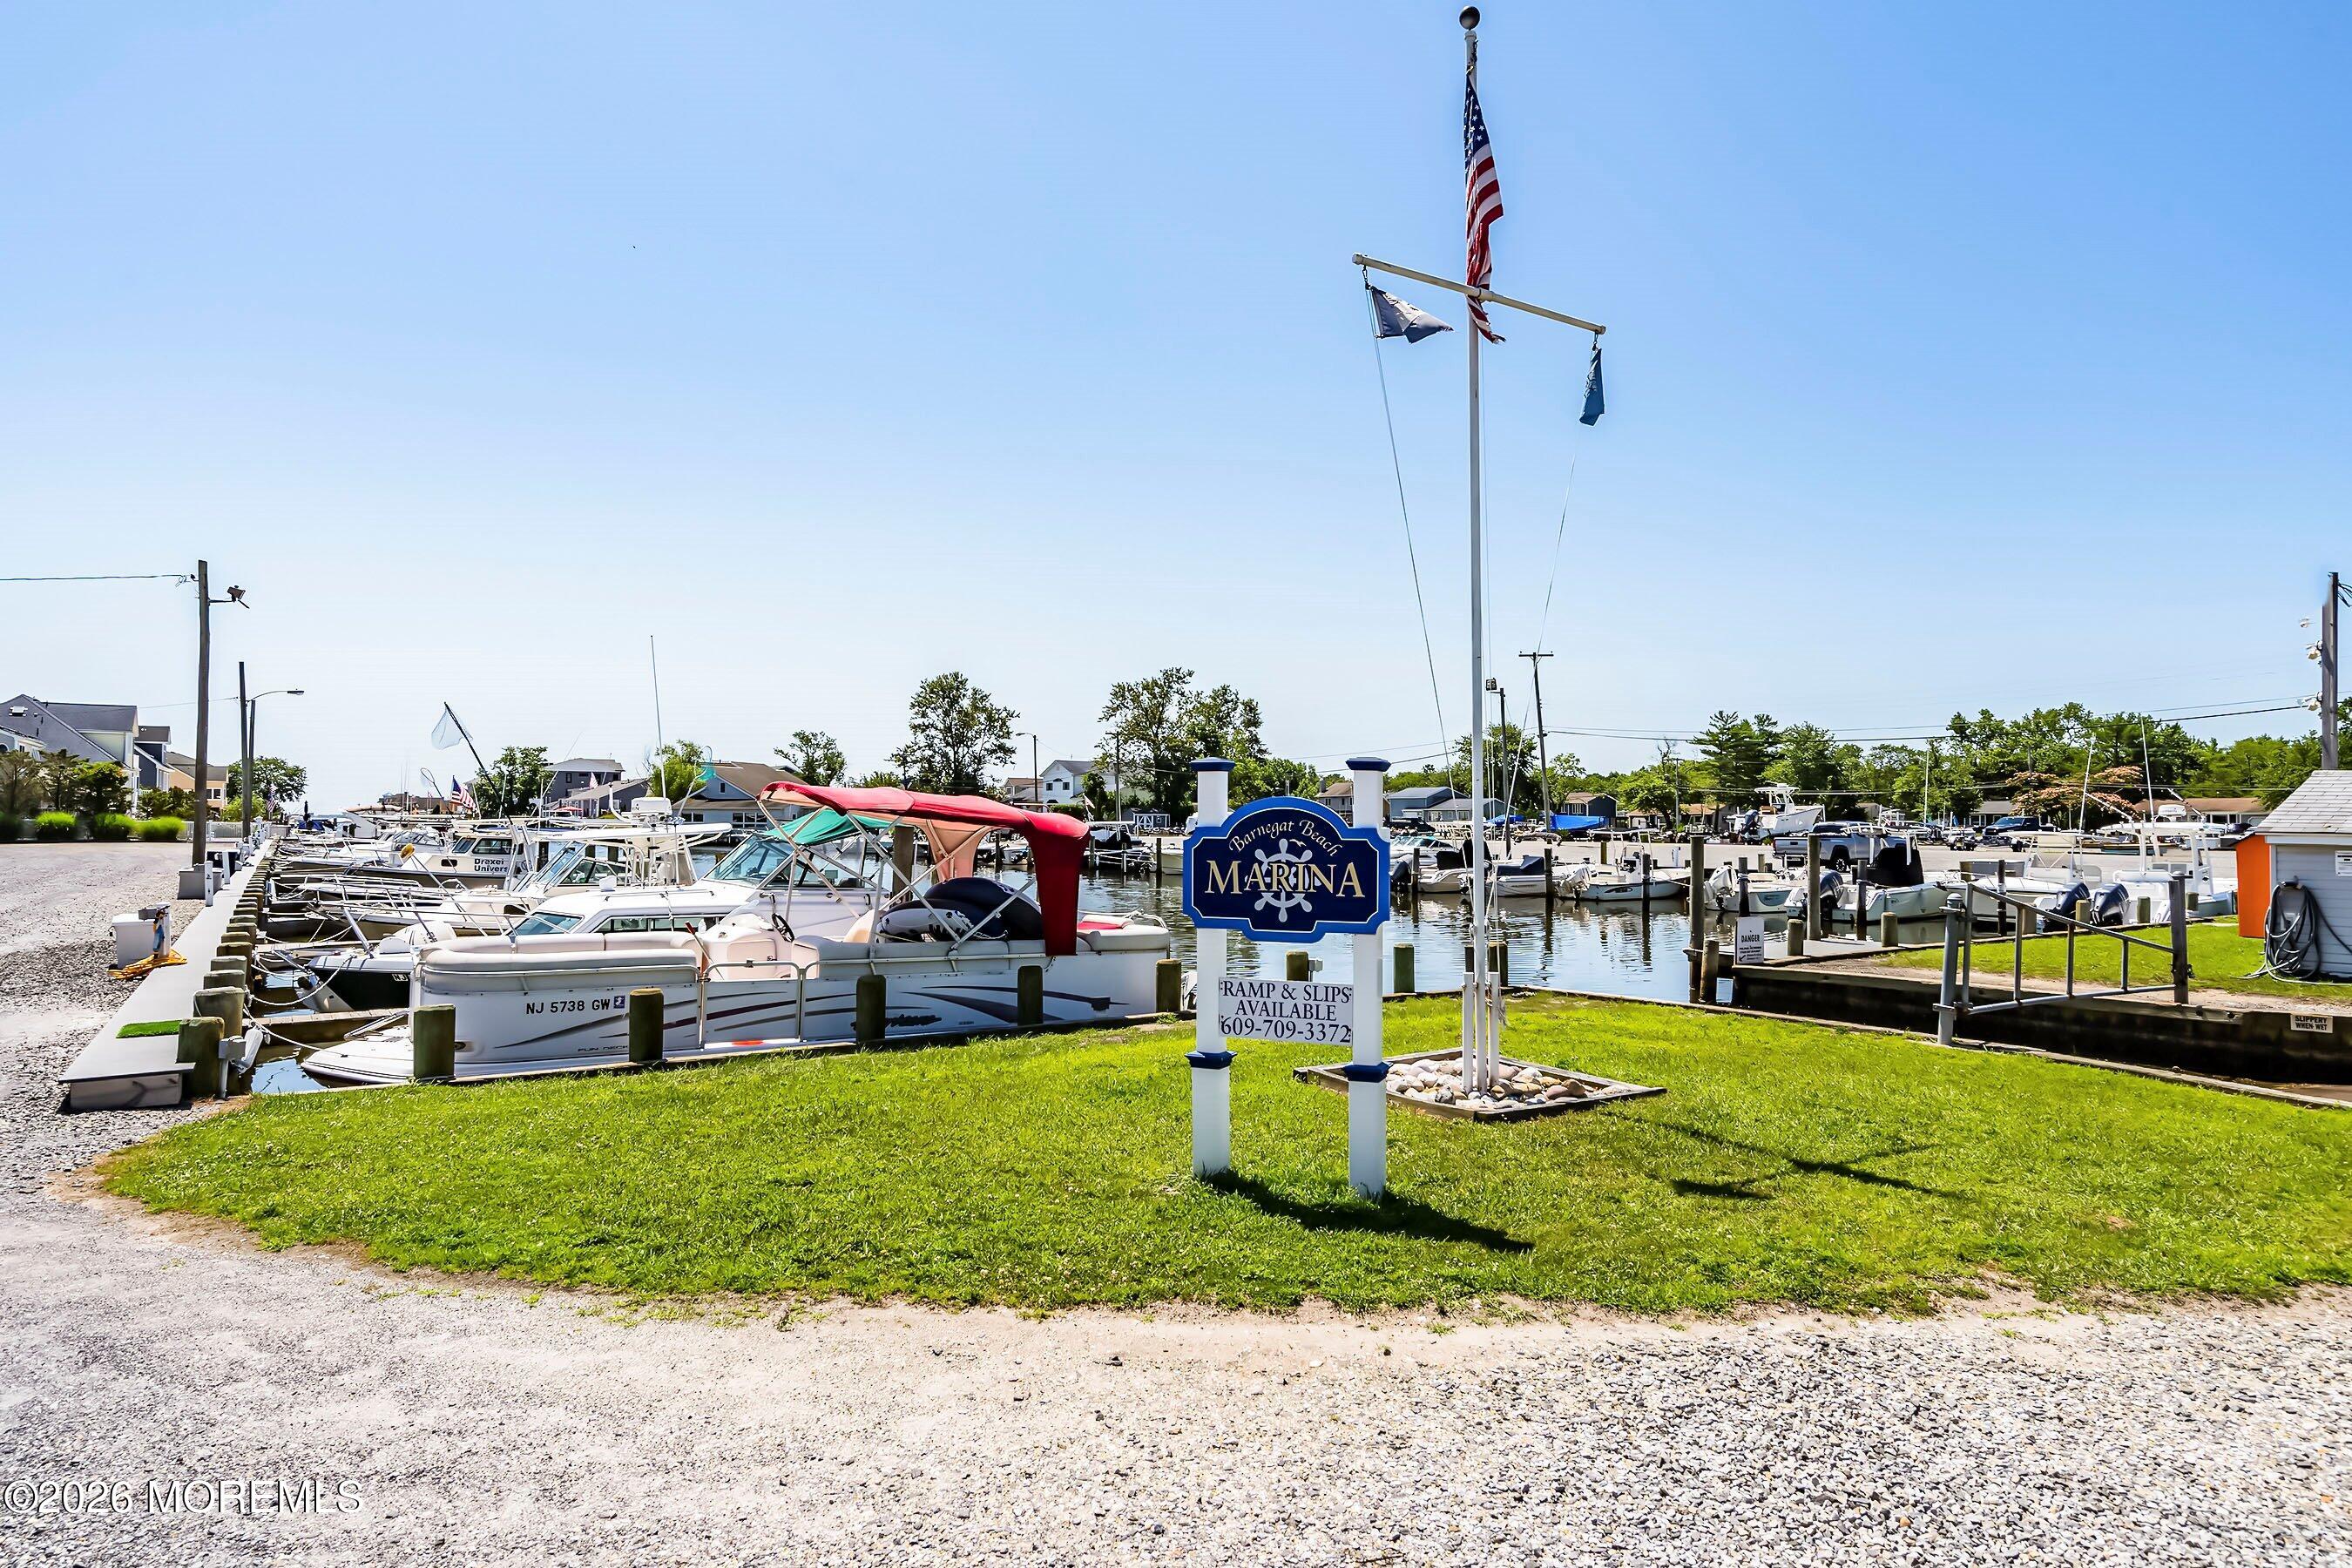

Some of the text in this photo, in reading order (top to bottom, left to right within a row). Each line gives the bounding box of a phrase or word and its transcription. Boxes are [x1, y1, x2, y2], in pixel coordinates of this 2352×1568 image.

[1229, 819, 1342, 856] Barnegat Beach
[1204, 860, 1365, 897] MARINA
[1222, 980, 1350, 1004] RAMP & SLIPS
[526, 998, 611, 1015] NJ 5738 GW
[1235, 1000, 1336, 1021] AVAILABLE
[1221, 1017, 1351, 1043] 609-709-3372
